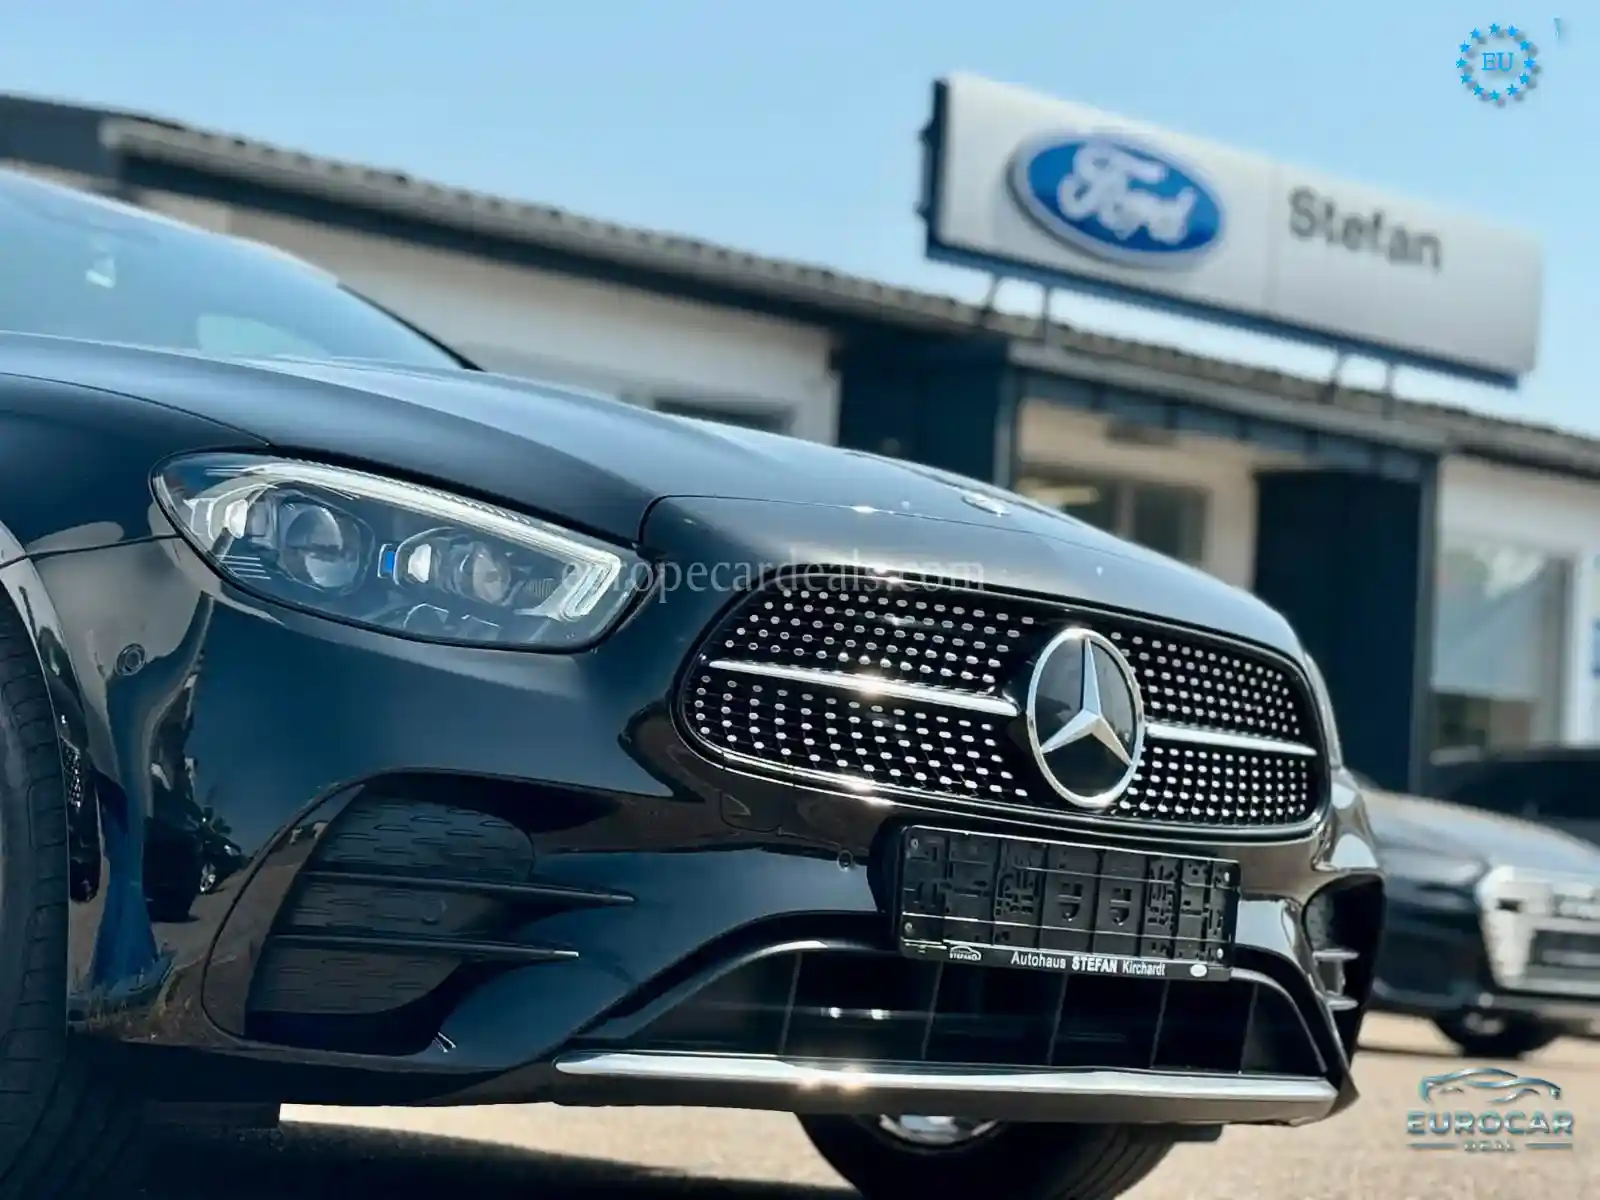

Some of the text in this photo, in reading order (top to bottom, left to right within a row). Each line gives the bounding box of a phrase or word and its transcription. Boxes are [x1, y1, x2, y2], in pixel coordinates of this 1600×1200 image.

[1057, 141, 1441, 271] Ford Stefan
[1011, 951, 1166, 976] Autohaus STEFAN Kirchardt
